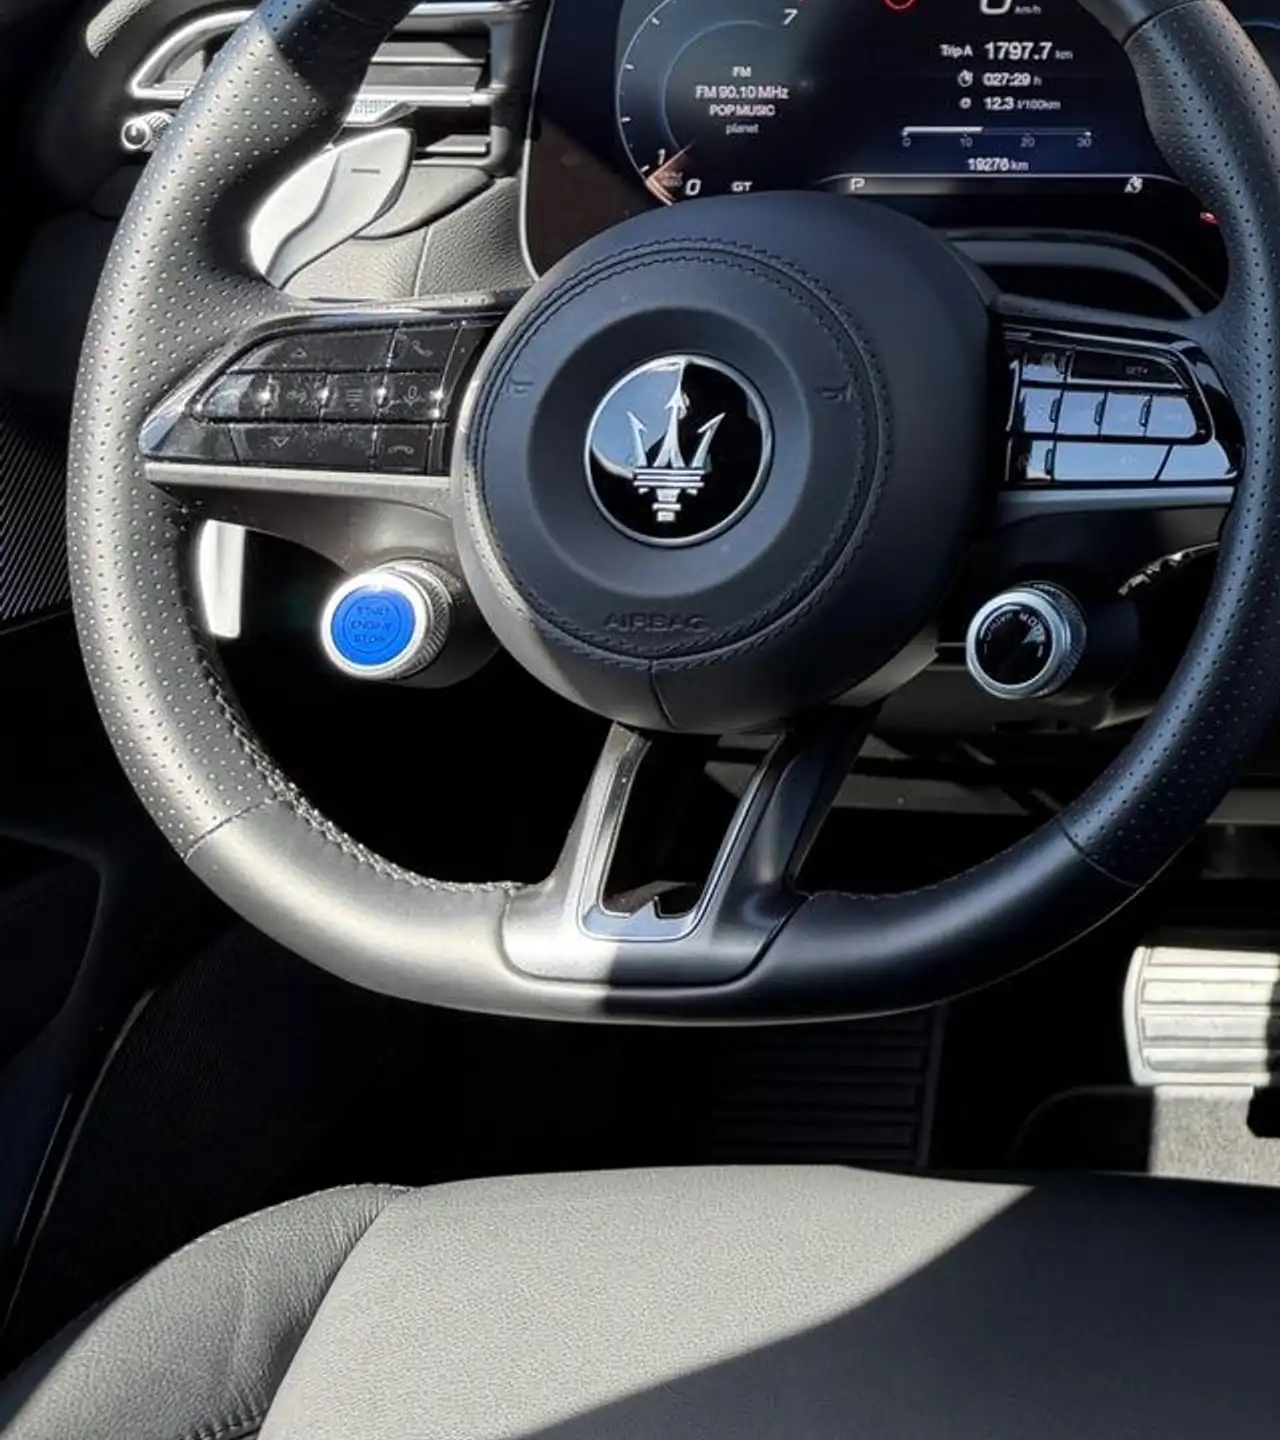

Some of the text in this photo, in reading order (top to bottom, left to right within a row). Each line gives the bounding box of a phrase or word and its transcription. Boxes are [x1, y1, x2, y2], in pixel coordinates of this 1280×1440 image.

[782, 9, 798, 25] 7
[984, 41, 1053, 61] 1797.7
[1055, 48, 1074, 60] km
[732, 66, 752, 78] FM
[1032, 75, 1042, 86] h
[695, 85, 717, 99] FM
[757, 85, 790, 99] MHz
[709, 104, 776, 116] POP MUSIC
[983, 96, 1015, 111] 12.3
[725, 123, 759, 135] planet
[902, 136, 1092, 148] 0 10 20 30
[1010, 159, 1029, 171] km
[684, 178, 702, 196] 0
[731, 180, 753, 193] GT
[851, 178, 866, 192] P
